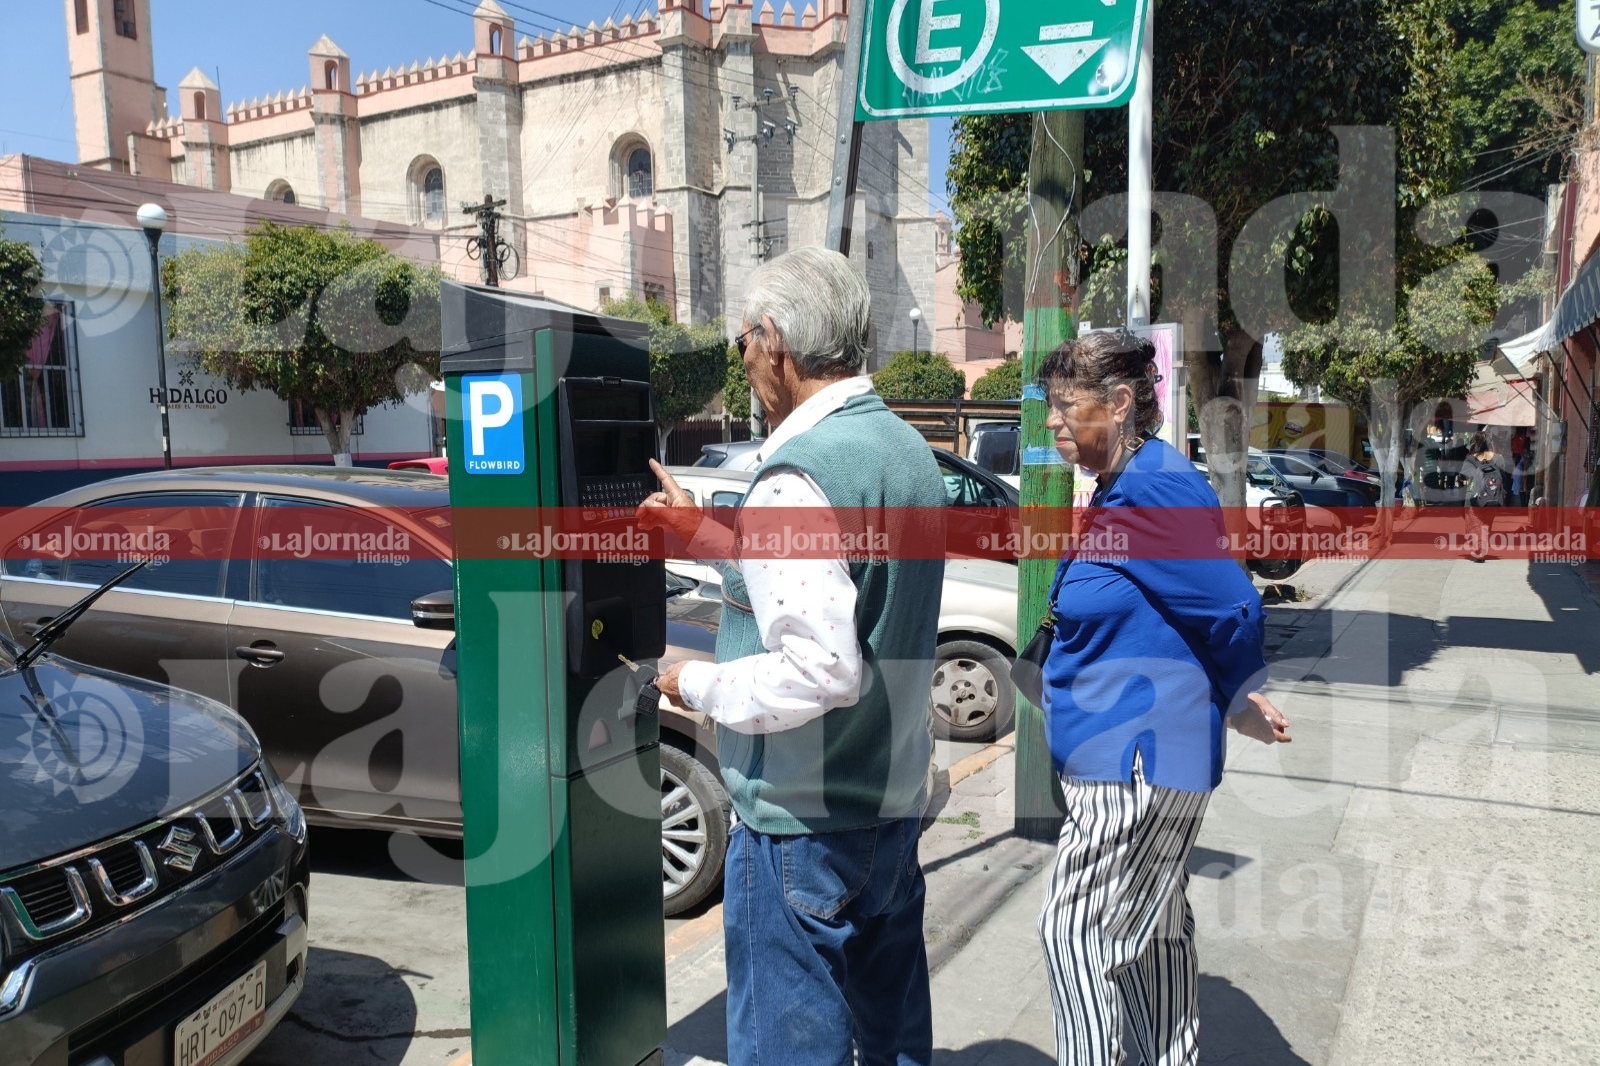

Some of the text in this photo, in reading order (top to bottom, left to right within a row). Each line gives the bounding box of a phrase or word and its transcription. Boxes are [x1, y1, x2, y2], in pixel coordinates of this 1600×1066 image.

[914, 0, 962, 64] E
[149, 387, 228, 404] HDALGO
[469, 381, 514, 455] P
[469, 460, 520, 470] FLOWBIRD
[180, 981, 263, 1066] HRT-097-D
